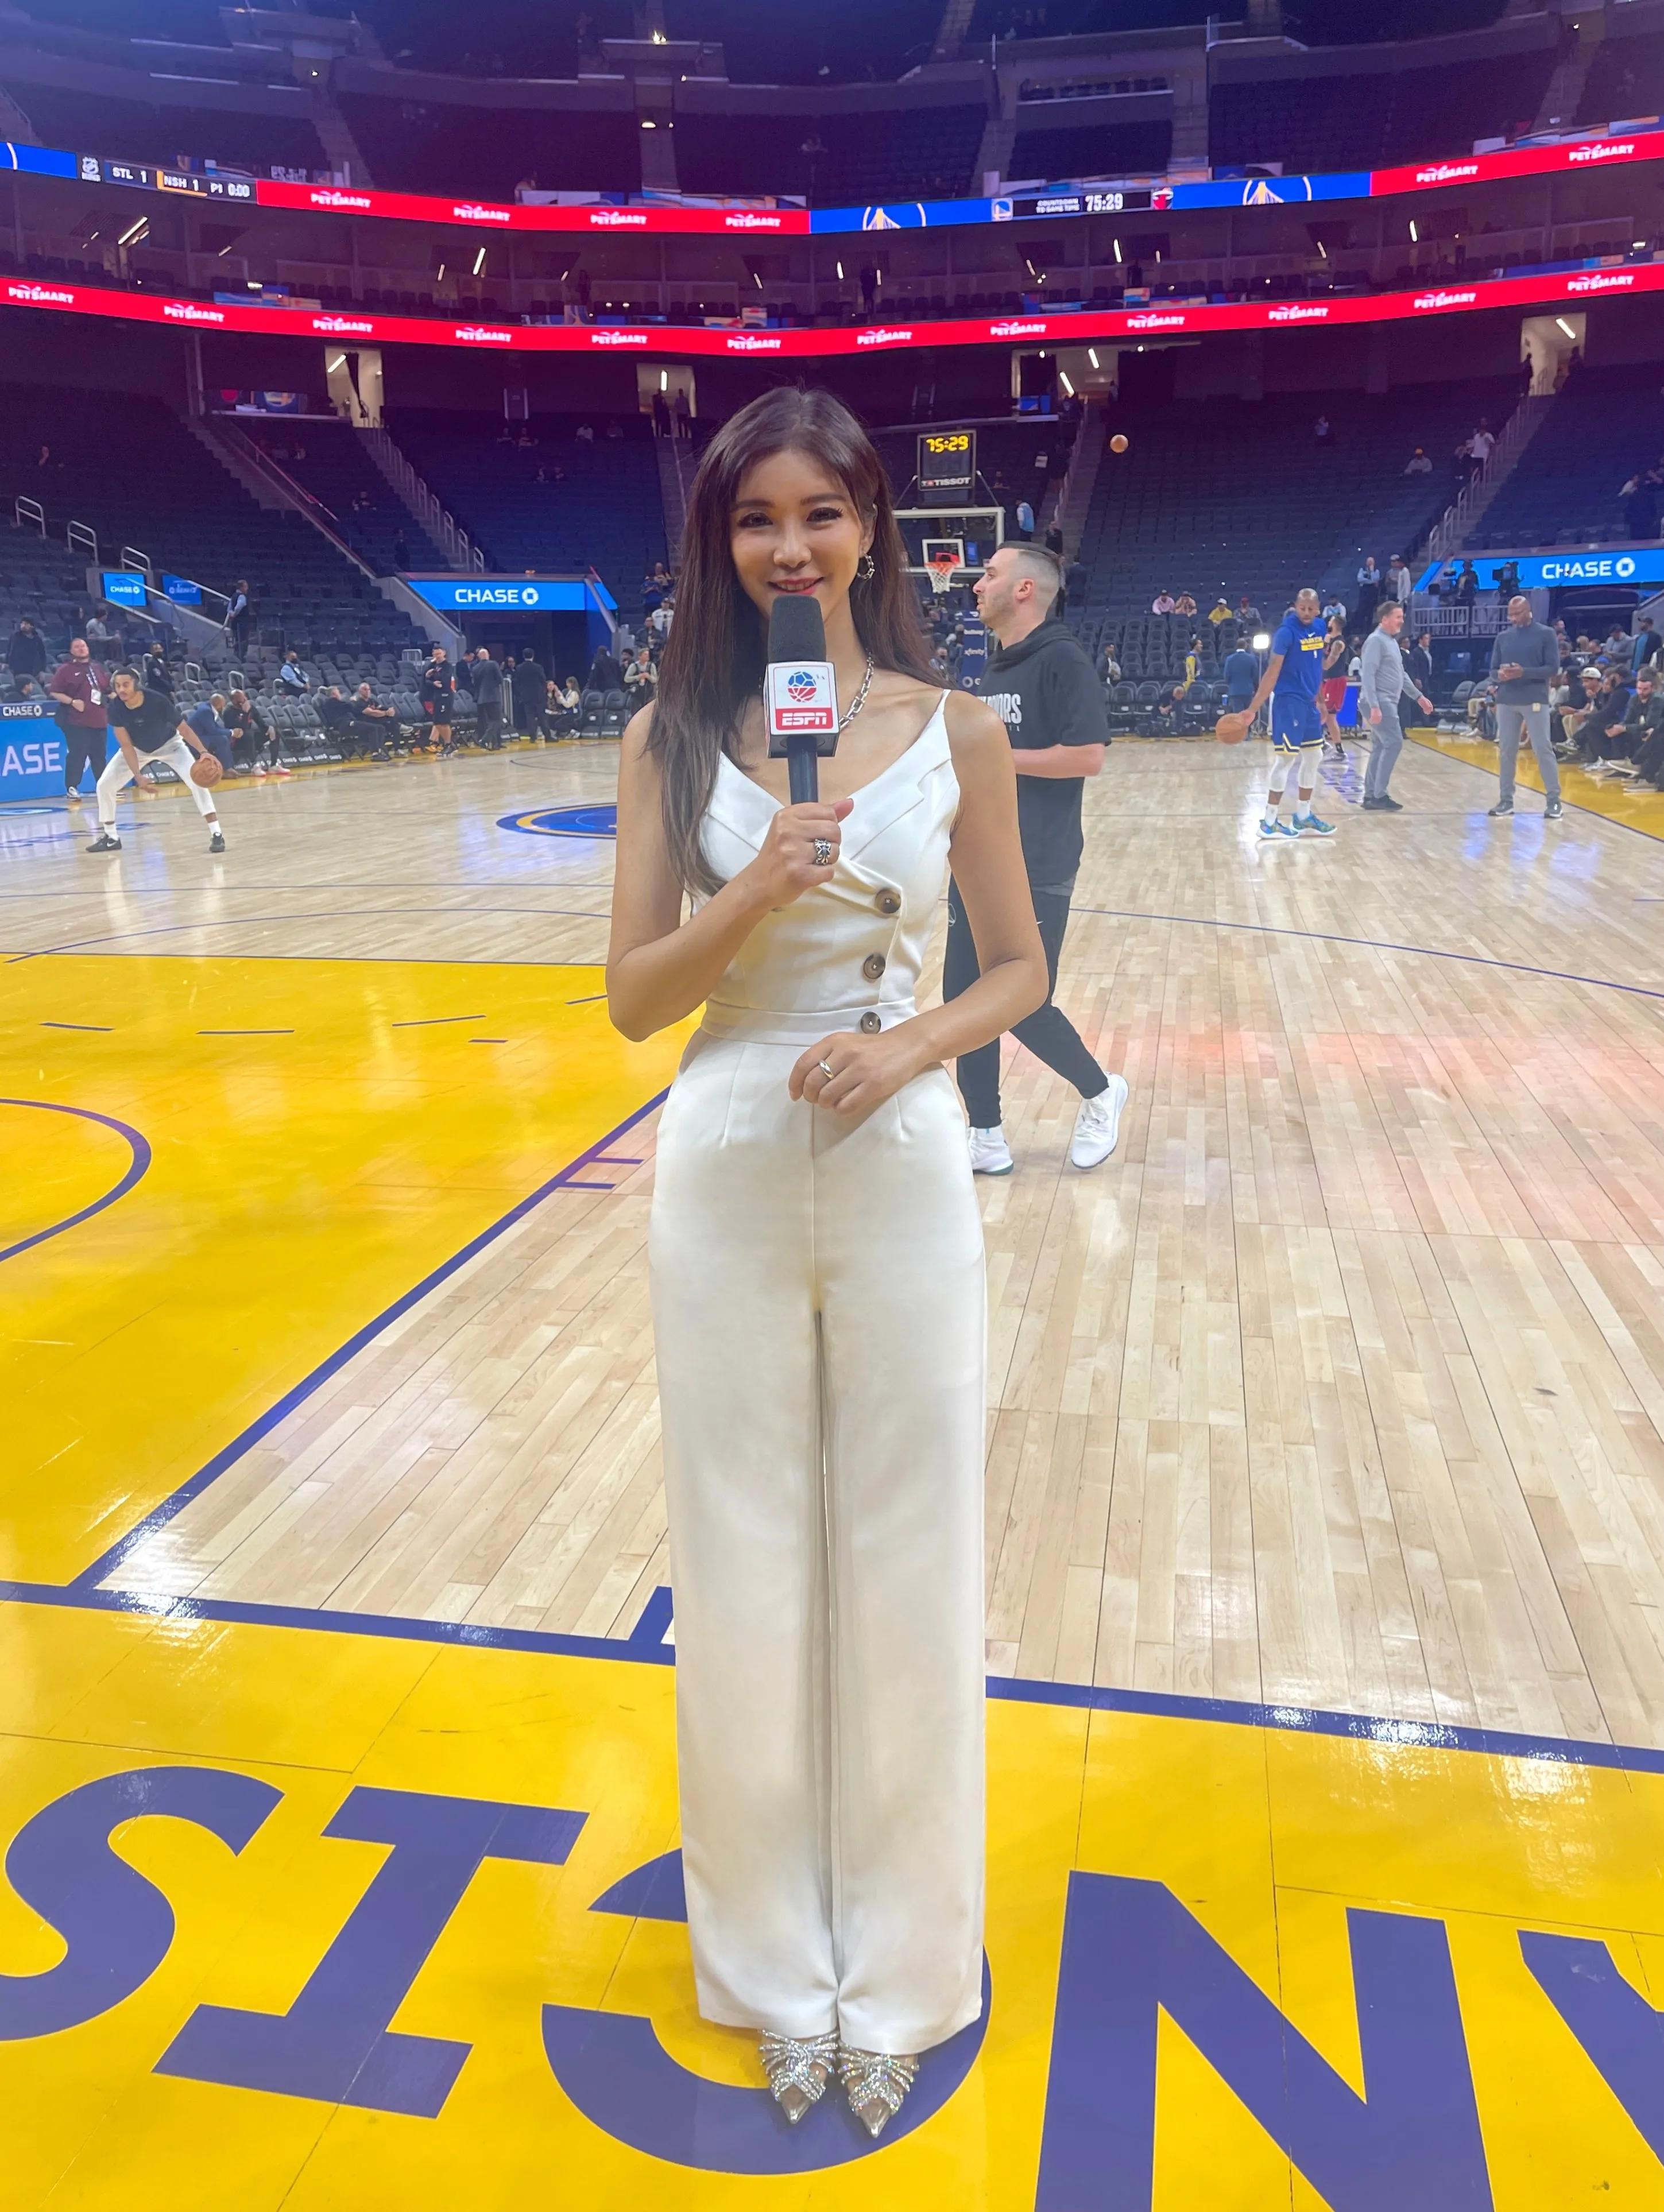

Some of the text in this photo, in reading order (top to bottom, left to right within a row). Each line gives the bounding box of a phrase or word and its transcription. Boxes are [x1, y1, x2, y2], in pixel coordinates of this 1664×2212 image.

[113, 166, 133, 179] STL
[140, 170, 147, 183] 1
[164, 175, 187, 188] NSH
[1085, 193, 1124, 212] 75:29
[926, 435, 969, 453] 75:29
[934, 477, 972, 486] TISSOT
[1542, 560, 1613, 579] CHASE
[455, 588, 520, 603] CHASE
[2, 706, 33, 716] CHASE
[781, 712, 827, 726] ESPN
[0, 742, 63, 776] ASE
